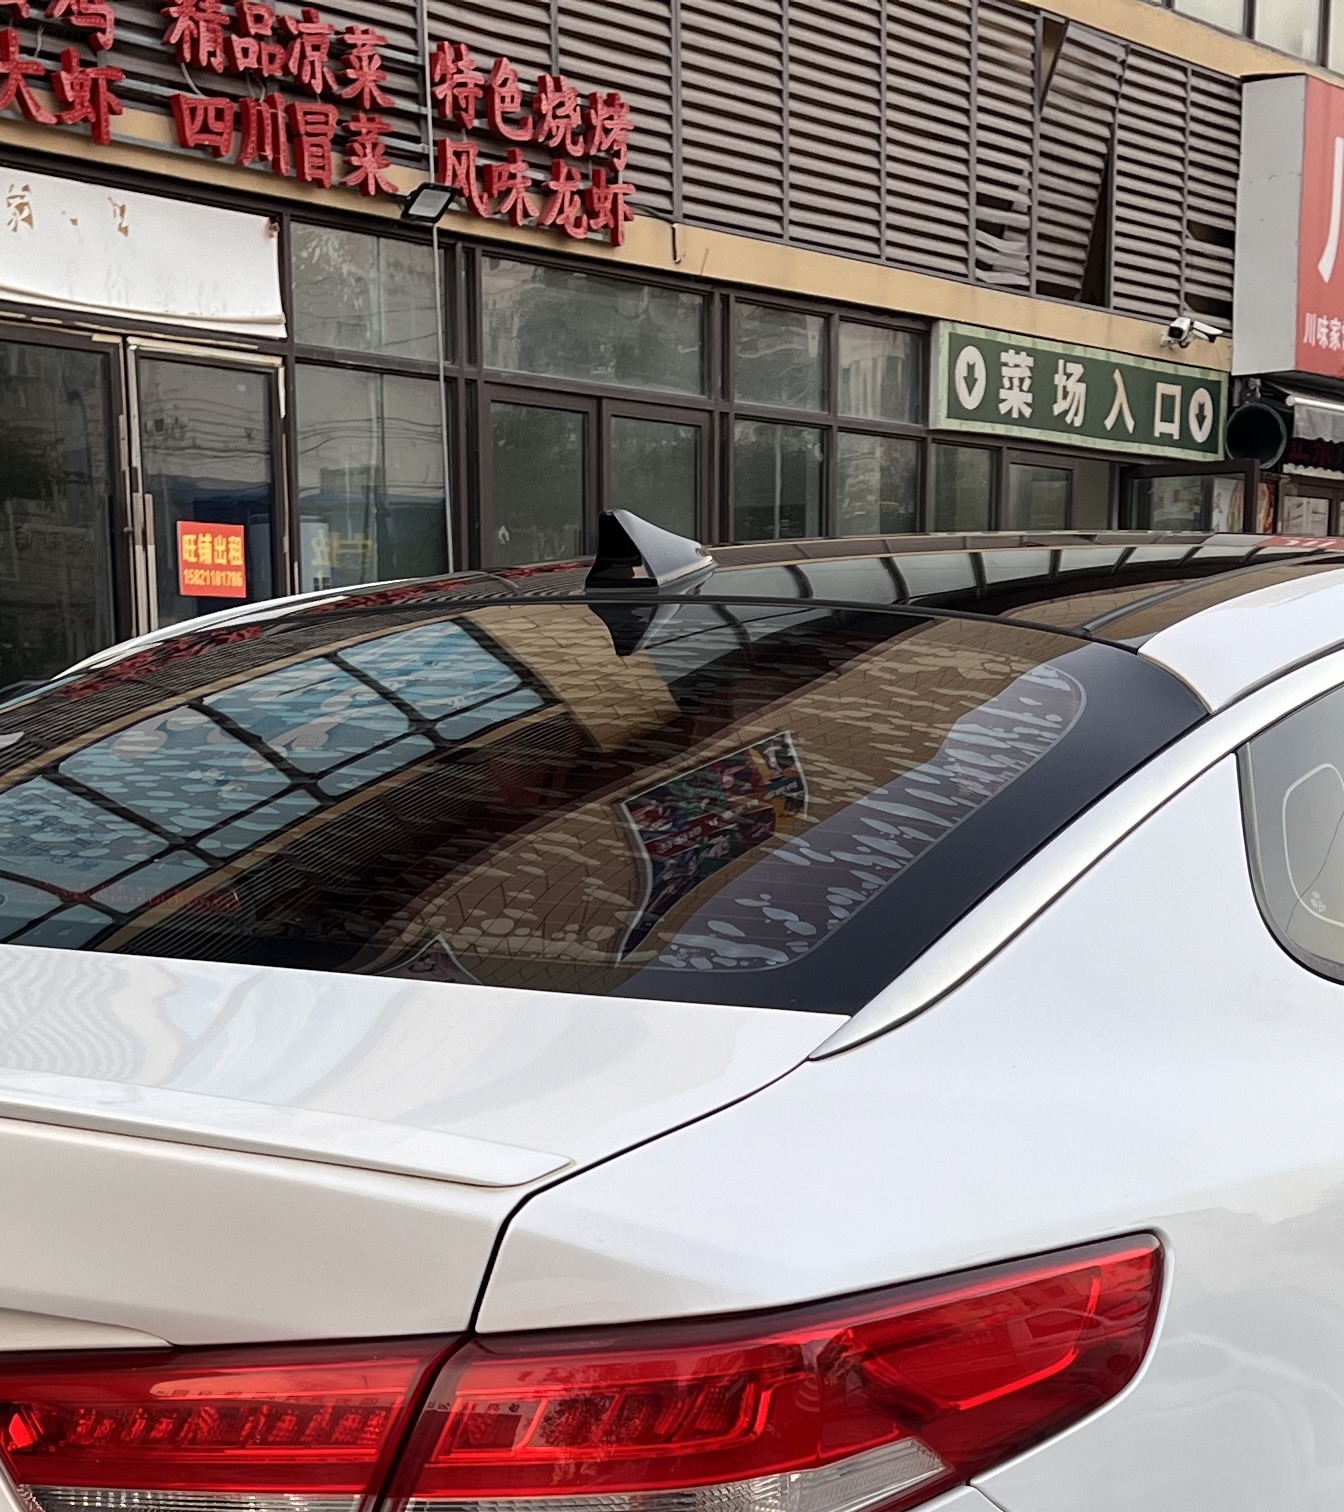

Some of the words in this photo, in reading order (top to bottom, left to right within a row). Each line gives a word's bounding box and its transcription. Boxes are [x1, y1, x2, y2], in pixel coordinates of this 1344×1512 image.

[162, 0, 396, 108] 精品凉菜
[429, 41, 635, 171] 特色烧烤
[171, 93, 400, 196] 四川冒菜
[437, 137, 637, 247] 风味龙虾
[997, 348, 1182, 440] 菜场入口
[182, 533, 244, 566] 旺铺出租
